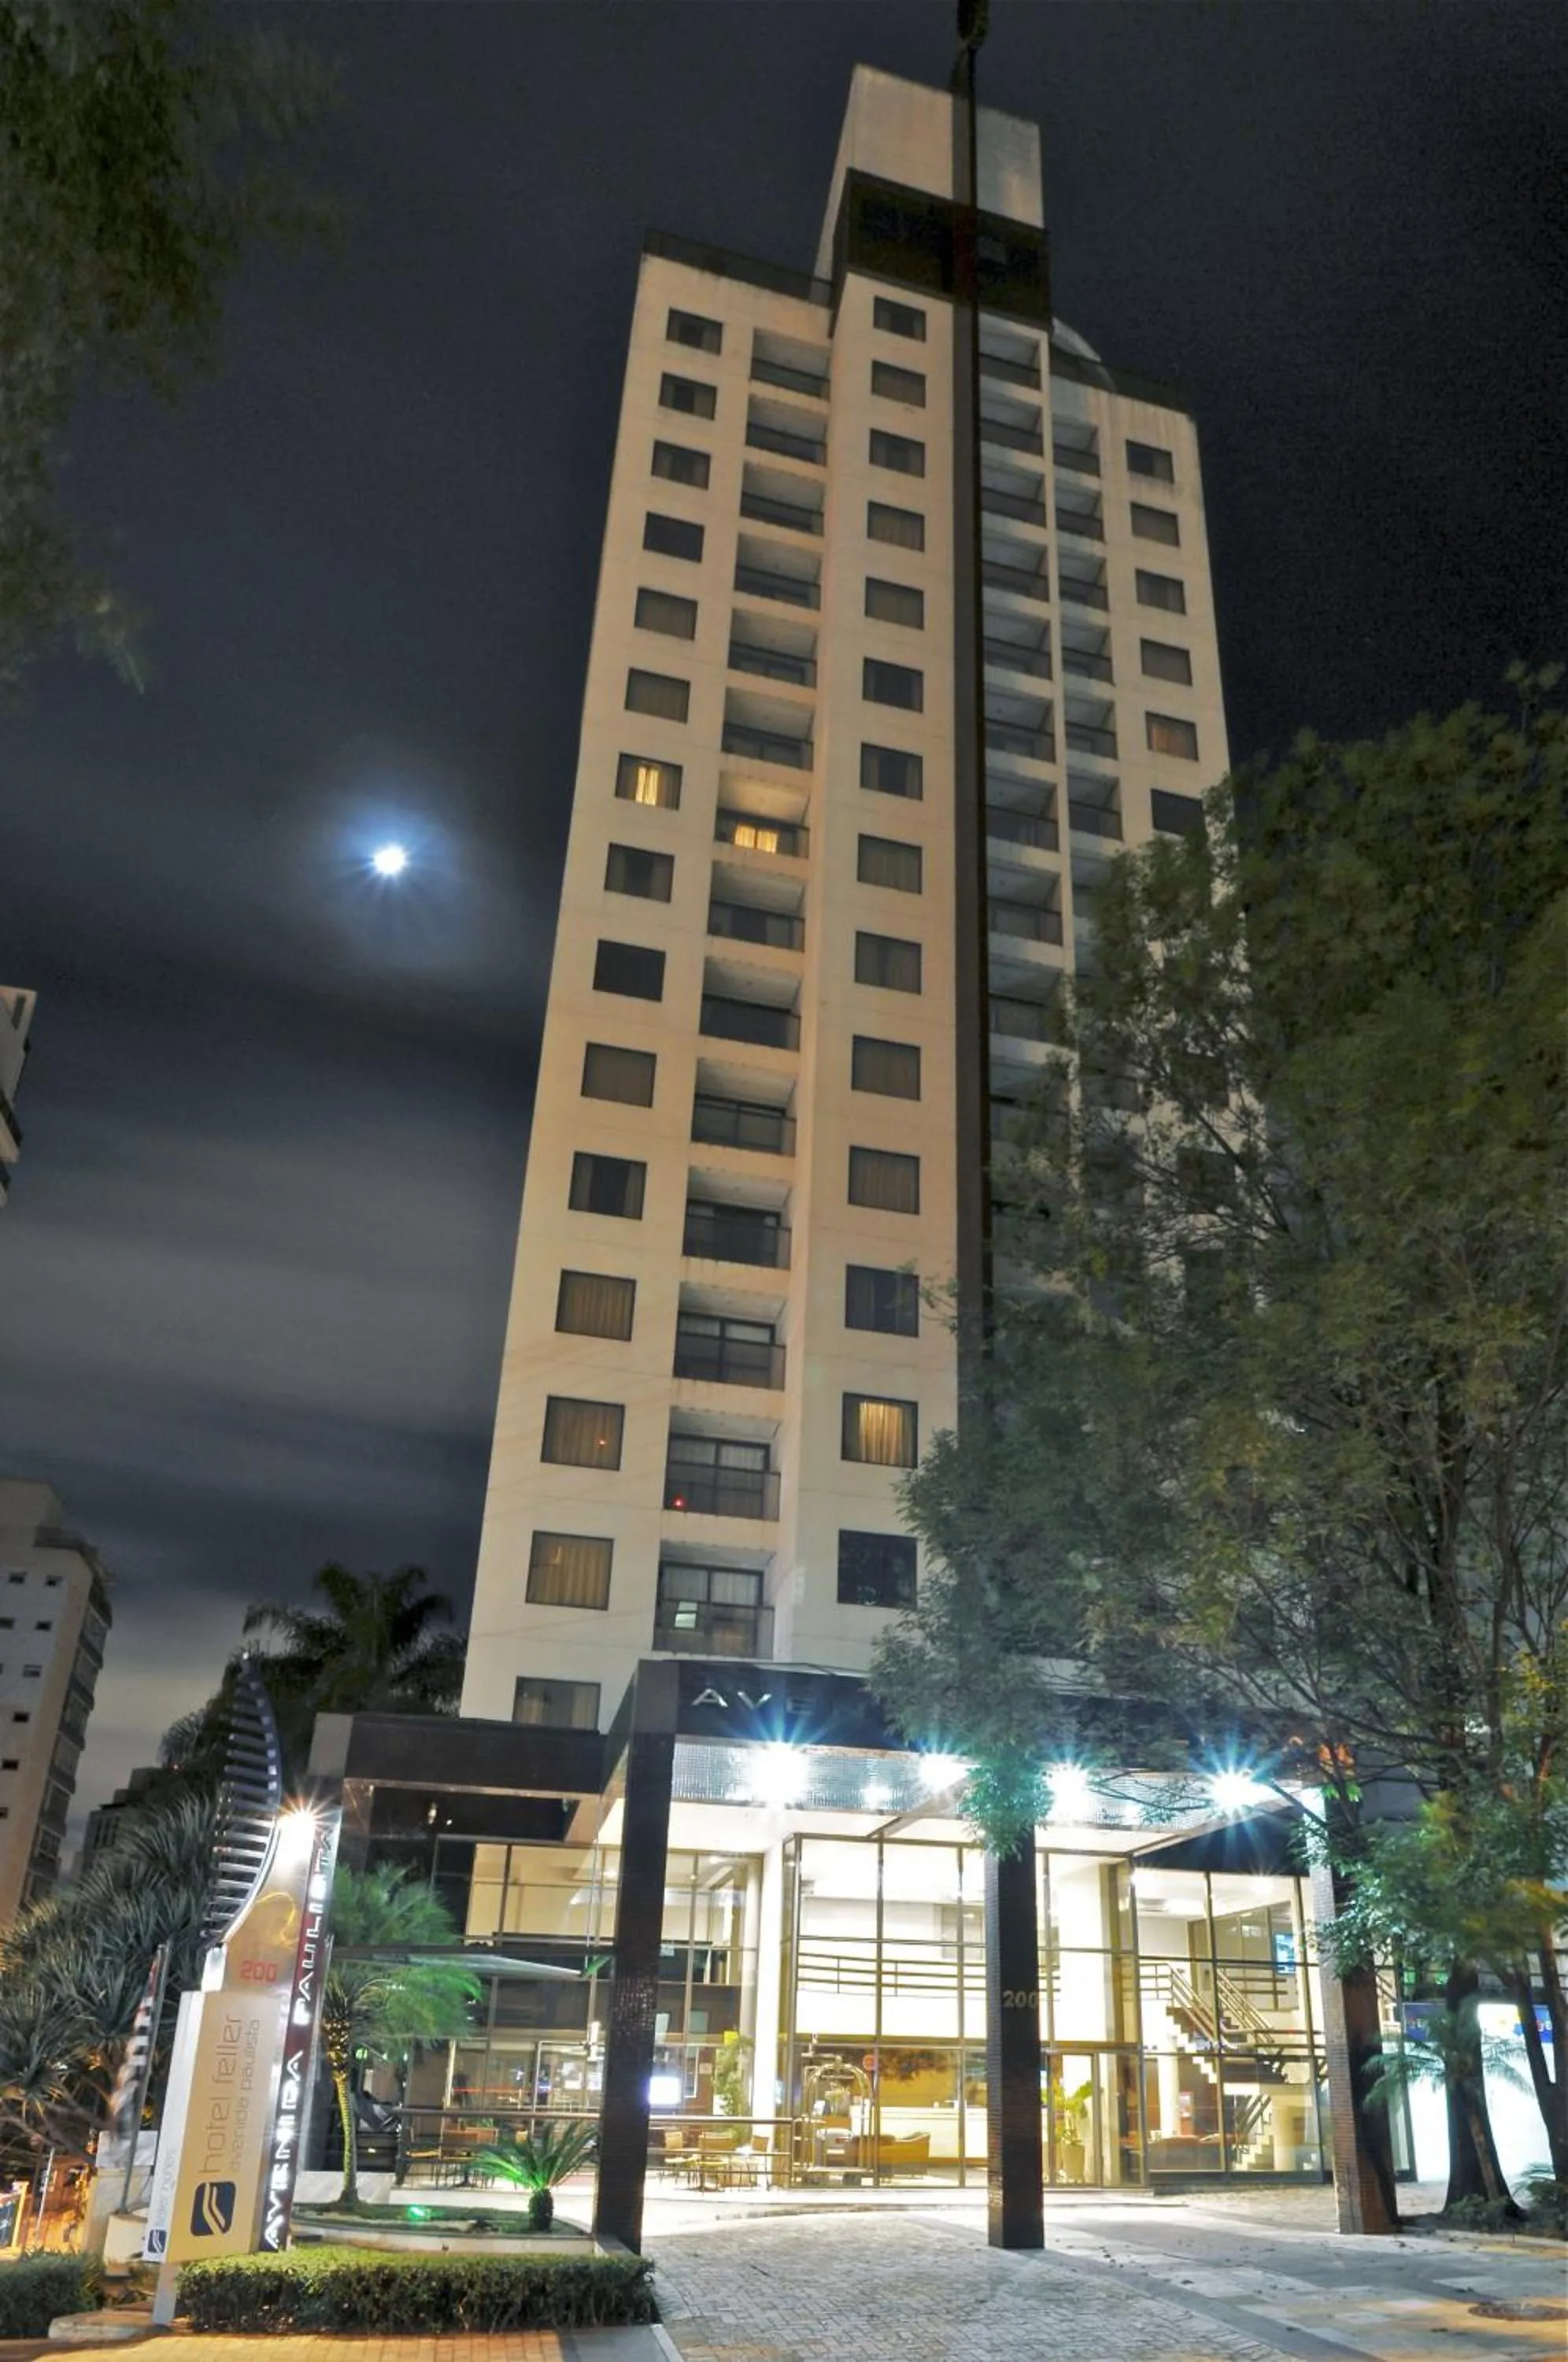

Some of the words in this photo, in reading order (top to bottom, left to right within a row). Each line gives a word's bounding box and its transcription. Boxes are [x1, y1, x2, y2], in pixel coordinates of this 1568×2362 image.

[240, 1960, 278, 1983] 200
[1003, 1990, 1037, 2009] 200
[212, 2015, 242, 2084] feller
[264, 2050, 304, 2249] AVENIDA
[292, 1828, 334, 2026] PAULISTA
[228, 2096, 250, 2171] avenida
[239, 2018, 261, 2091] paulista
[198, 2096, 232, 2173] hotel
